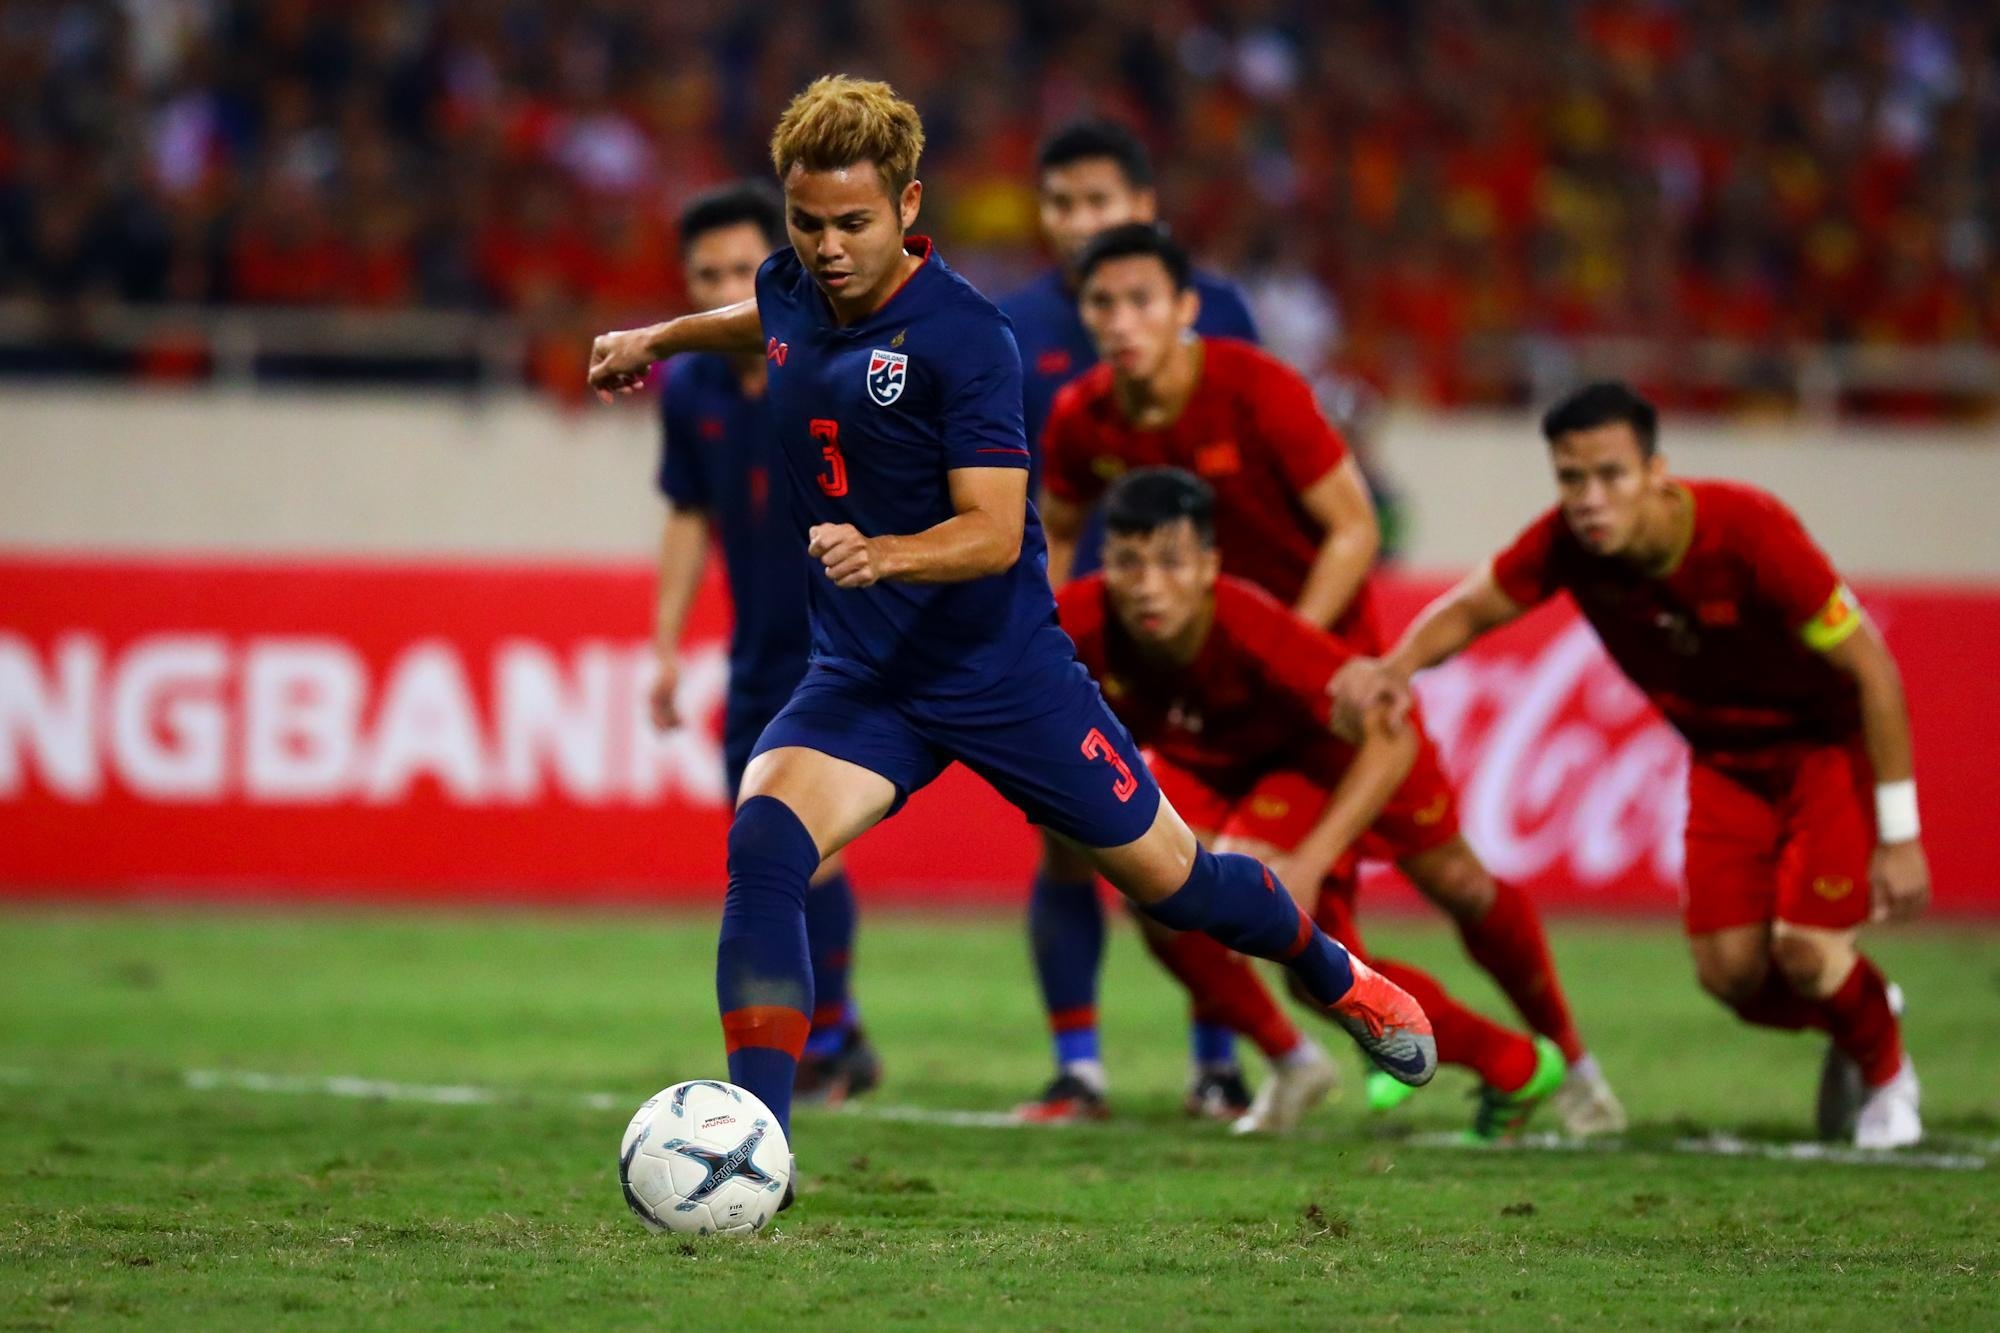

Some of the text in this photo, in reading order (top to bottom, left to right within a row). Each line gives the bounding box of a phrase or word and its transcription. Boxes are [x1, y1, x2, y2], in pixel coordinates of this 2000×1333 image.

[874, 352, 905, 363] THAILAND
[809, 418, 848, 497] 3
[1081, 727, 1138, 802] 3
[701, 1117, 736, 1130] MUNDO
